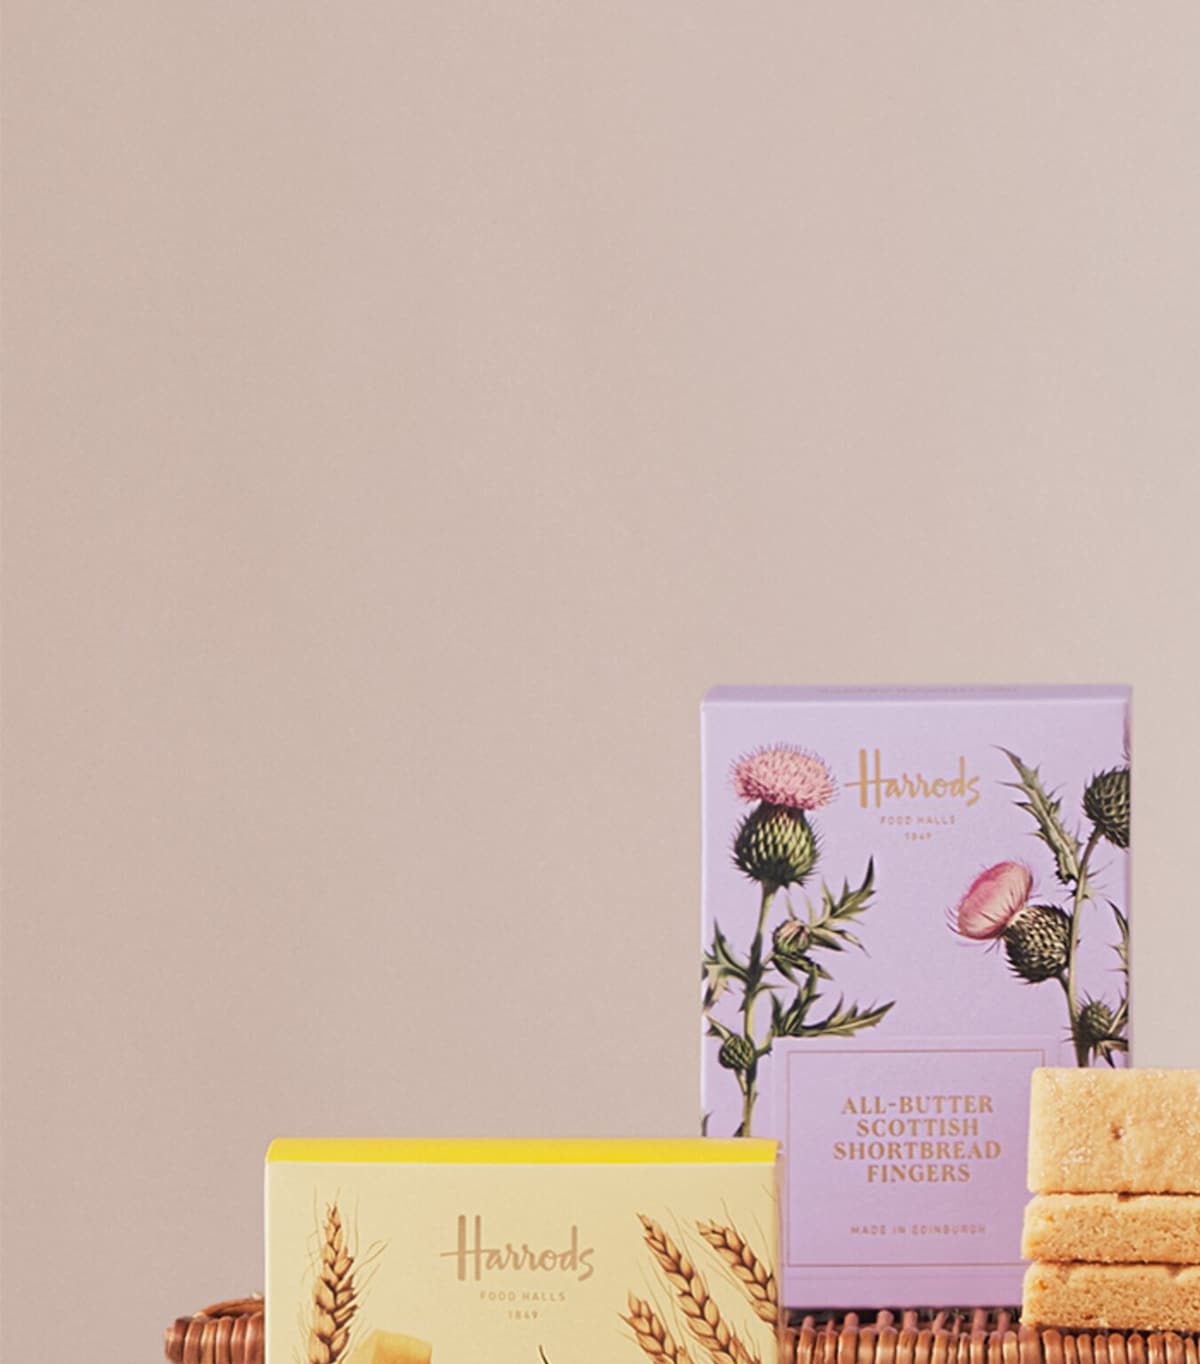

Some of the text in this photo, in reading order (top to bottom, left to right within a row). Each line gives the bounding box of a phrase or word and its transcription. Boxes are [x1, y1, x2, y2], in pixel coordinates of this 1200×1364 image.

[844, 749, 981, 808] Harrods
[881, 815, 912, 825] FOOD
[841, 1095, 994, 1115] ALL-BUTTER
[856, 1118, 979, 1137] SCOTTISH
[833, 1140, 1002, 1160] SHORTBREAD
[866, 1164, 971, 1183] FINGERS
[850, 1224, 886, 1235] MADE
[892, 1225, 906, 1234] IN
[440, 1214, 594, 1282] Harrods
[480, 1290, 566, 1302] FOOD HALLS
